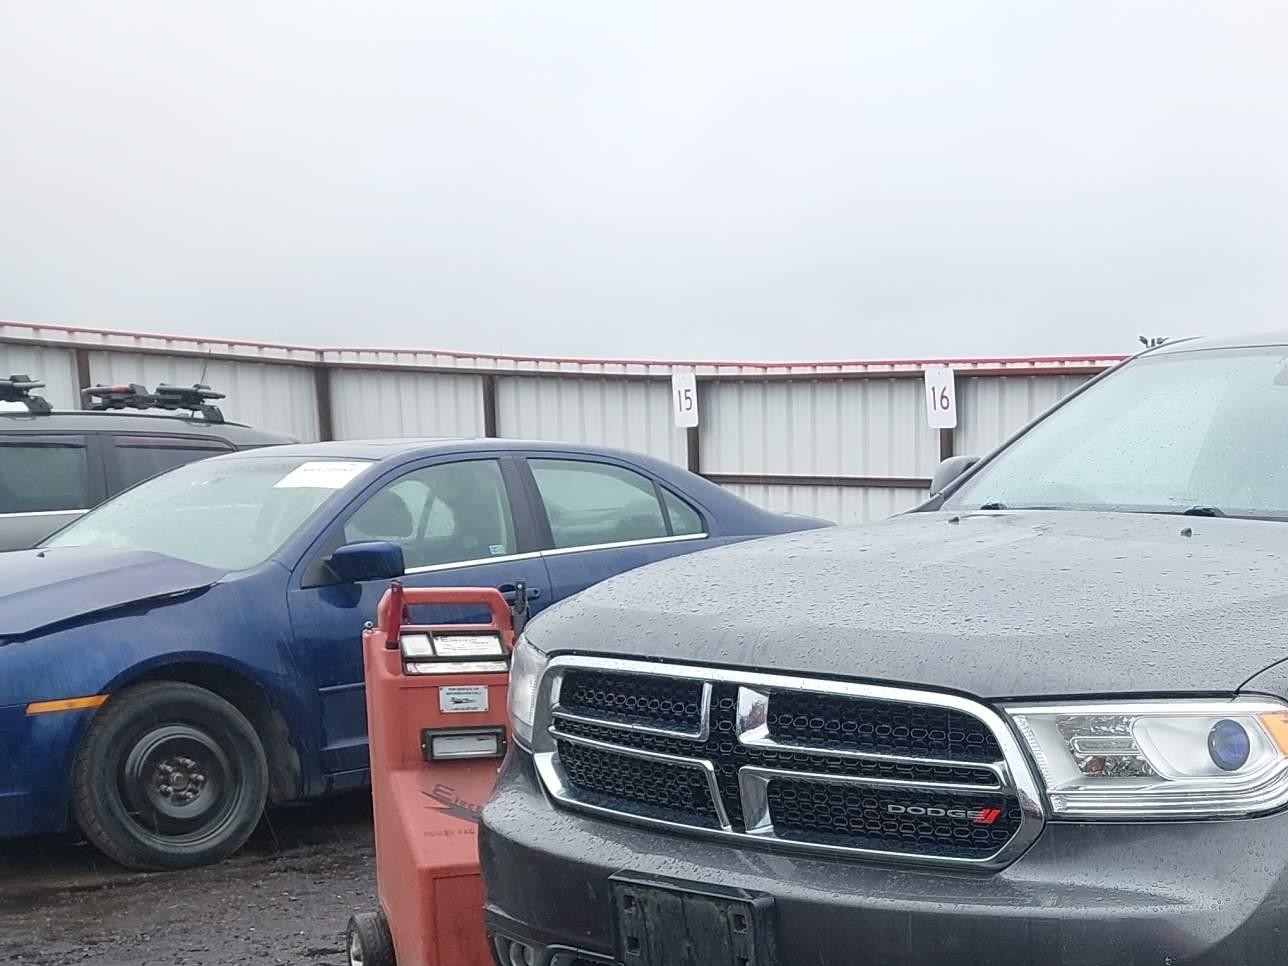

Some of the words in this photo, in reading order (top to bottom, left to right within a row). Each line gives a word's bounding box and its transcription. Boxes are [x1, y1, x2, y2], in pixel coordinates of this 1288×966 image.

[678, 388, 693, 412] 15
[931, 385, 950, 411] 16
[887, 804, 985, 819] DODGE
